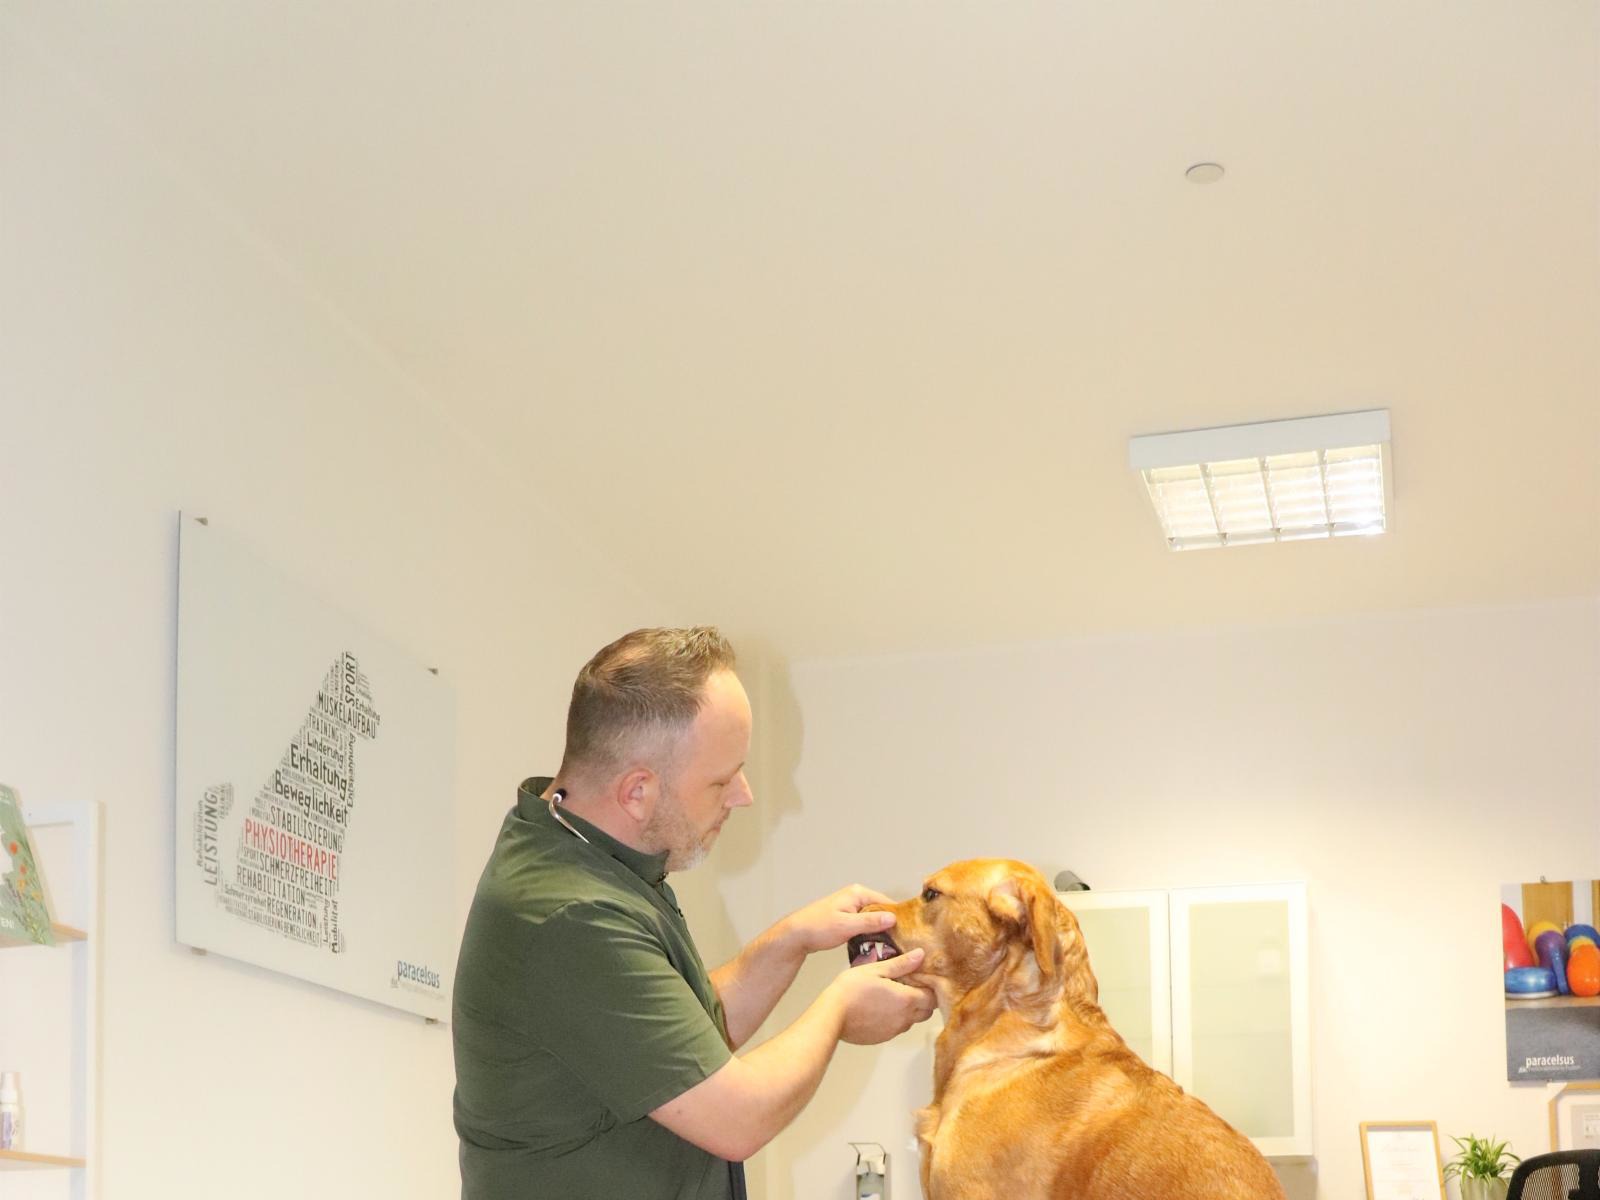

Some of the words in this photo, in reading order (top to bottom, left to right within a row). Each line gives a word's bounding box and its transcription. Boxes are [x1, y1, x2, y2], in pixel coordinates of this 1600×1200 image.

[345, 651, 356, 707] SPORT
[319, 690, 376, 739] MUSKELAUFBAU
[291, 743, 347, 801] Erhaltung
[307, 731, 344, 769] Linderung
[275, 769, 348, 827] Beweglichkeit
[204, 791, 218, 886] LEISTUNG
[244, 818, 337, 880] PHYSIOTHERAPIE
[270, 805, 342, 853] STABILISIERUNG
[236, 865, 306, 907] REHABILITATION
[259, 852, 334, 898] SCHMERZFREIHEIT
[267, 897, 317, 929] REGENERATION
[397, 960, 440, 989] paracelsus
[1525, 1054, 1575, 1069] paracelsus
